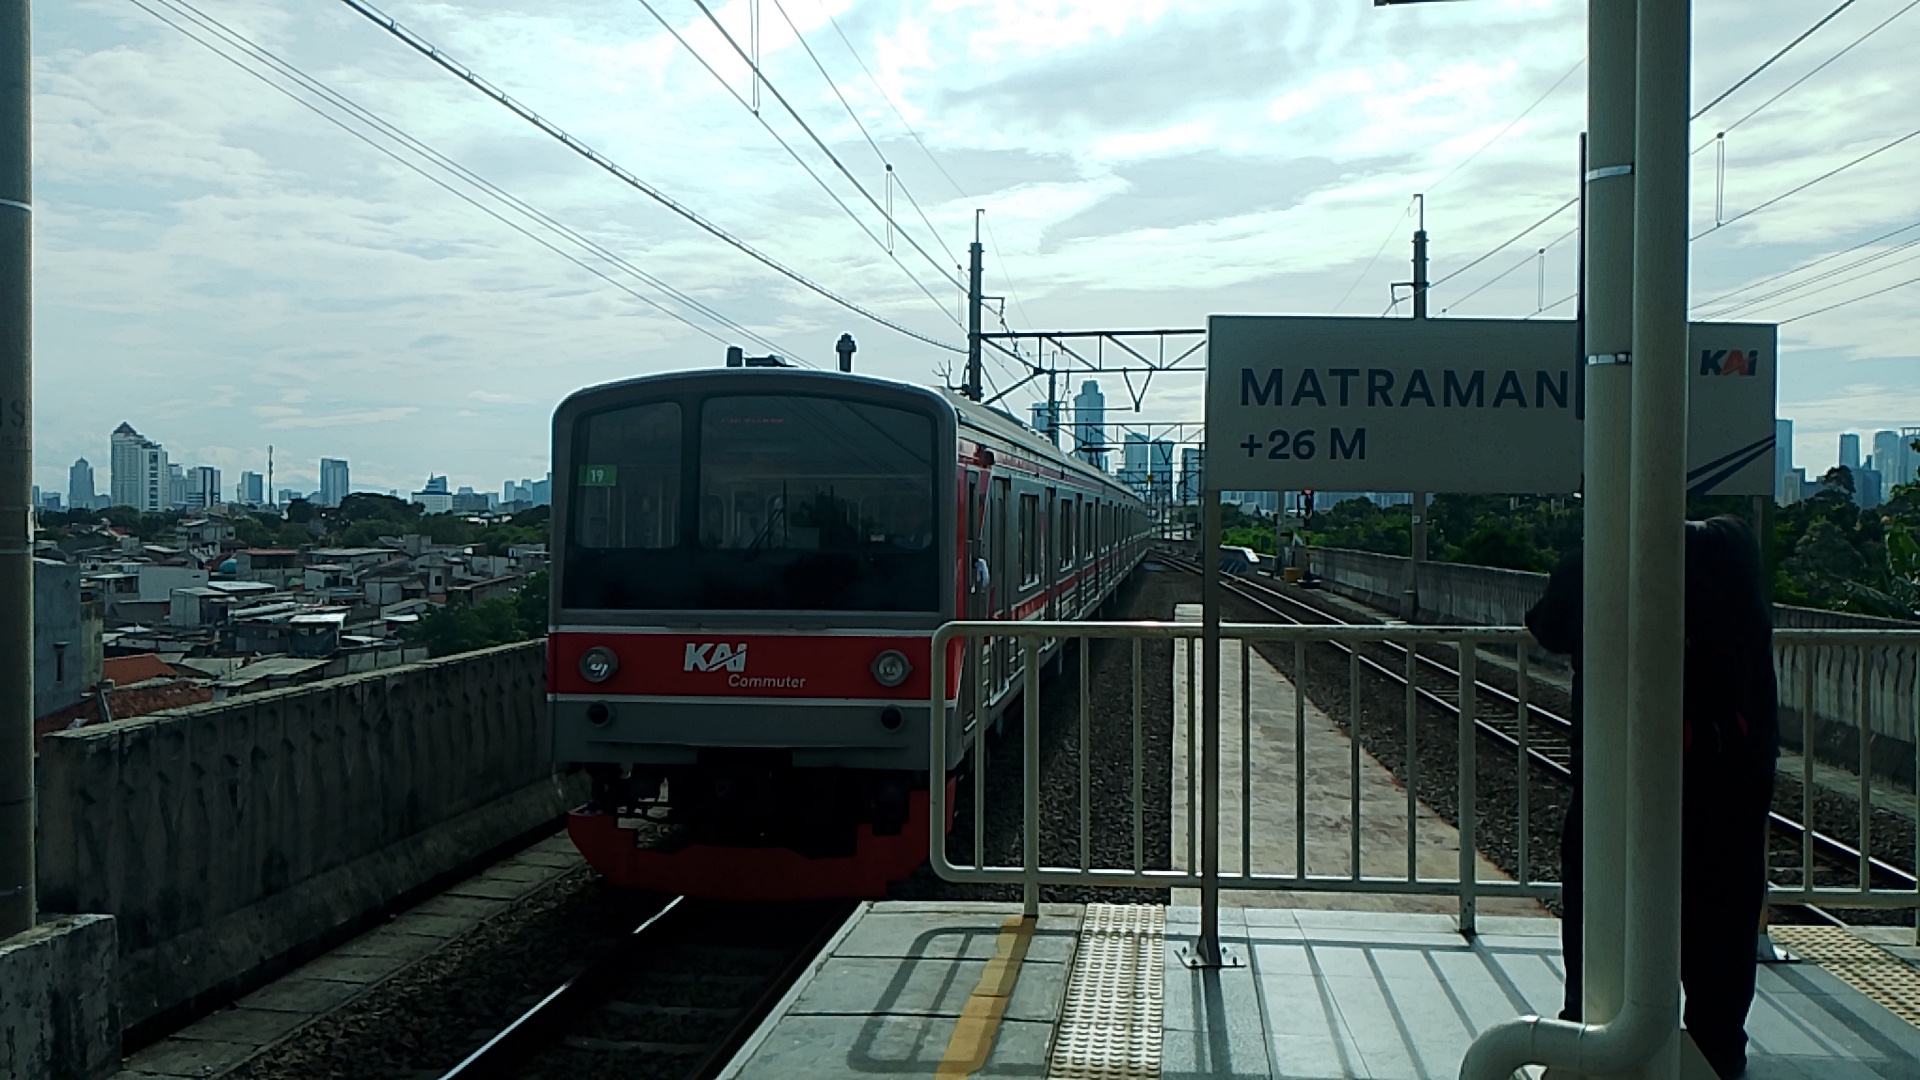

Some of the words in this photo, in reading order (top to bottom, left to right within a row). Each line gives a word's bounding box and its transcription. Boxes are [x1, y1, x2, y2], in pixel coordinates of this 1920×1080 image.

[1240, 368, 1569, 408] MATRAMAN
[1240, 429, 1316, 461] +26
[1329, 428, 1367, 460] M
[590, 469, 604, 483] 19
[727, 674, 806, 689] Commuter
